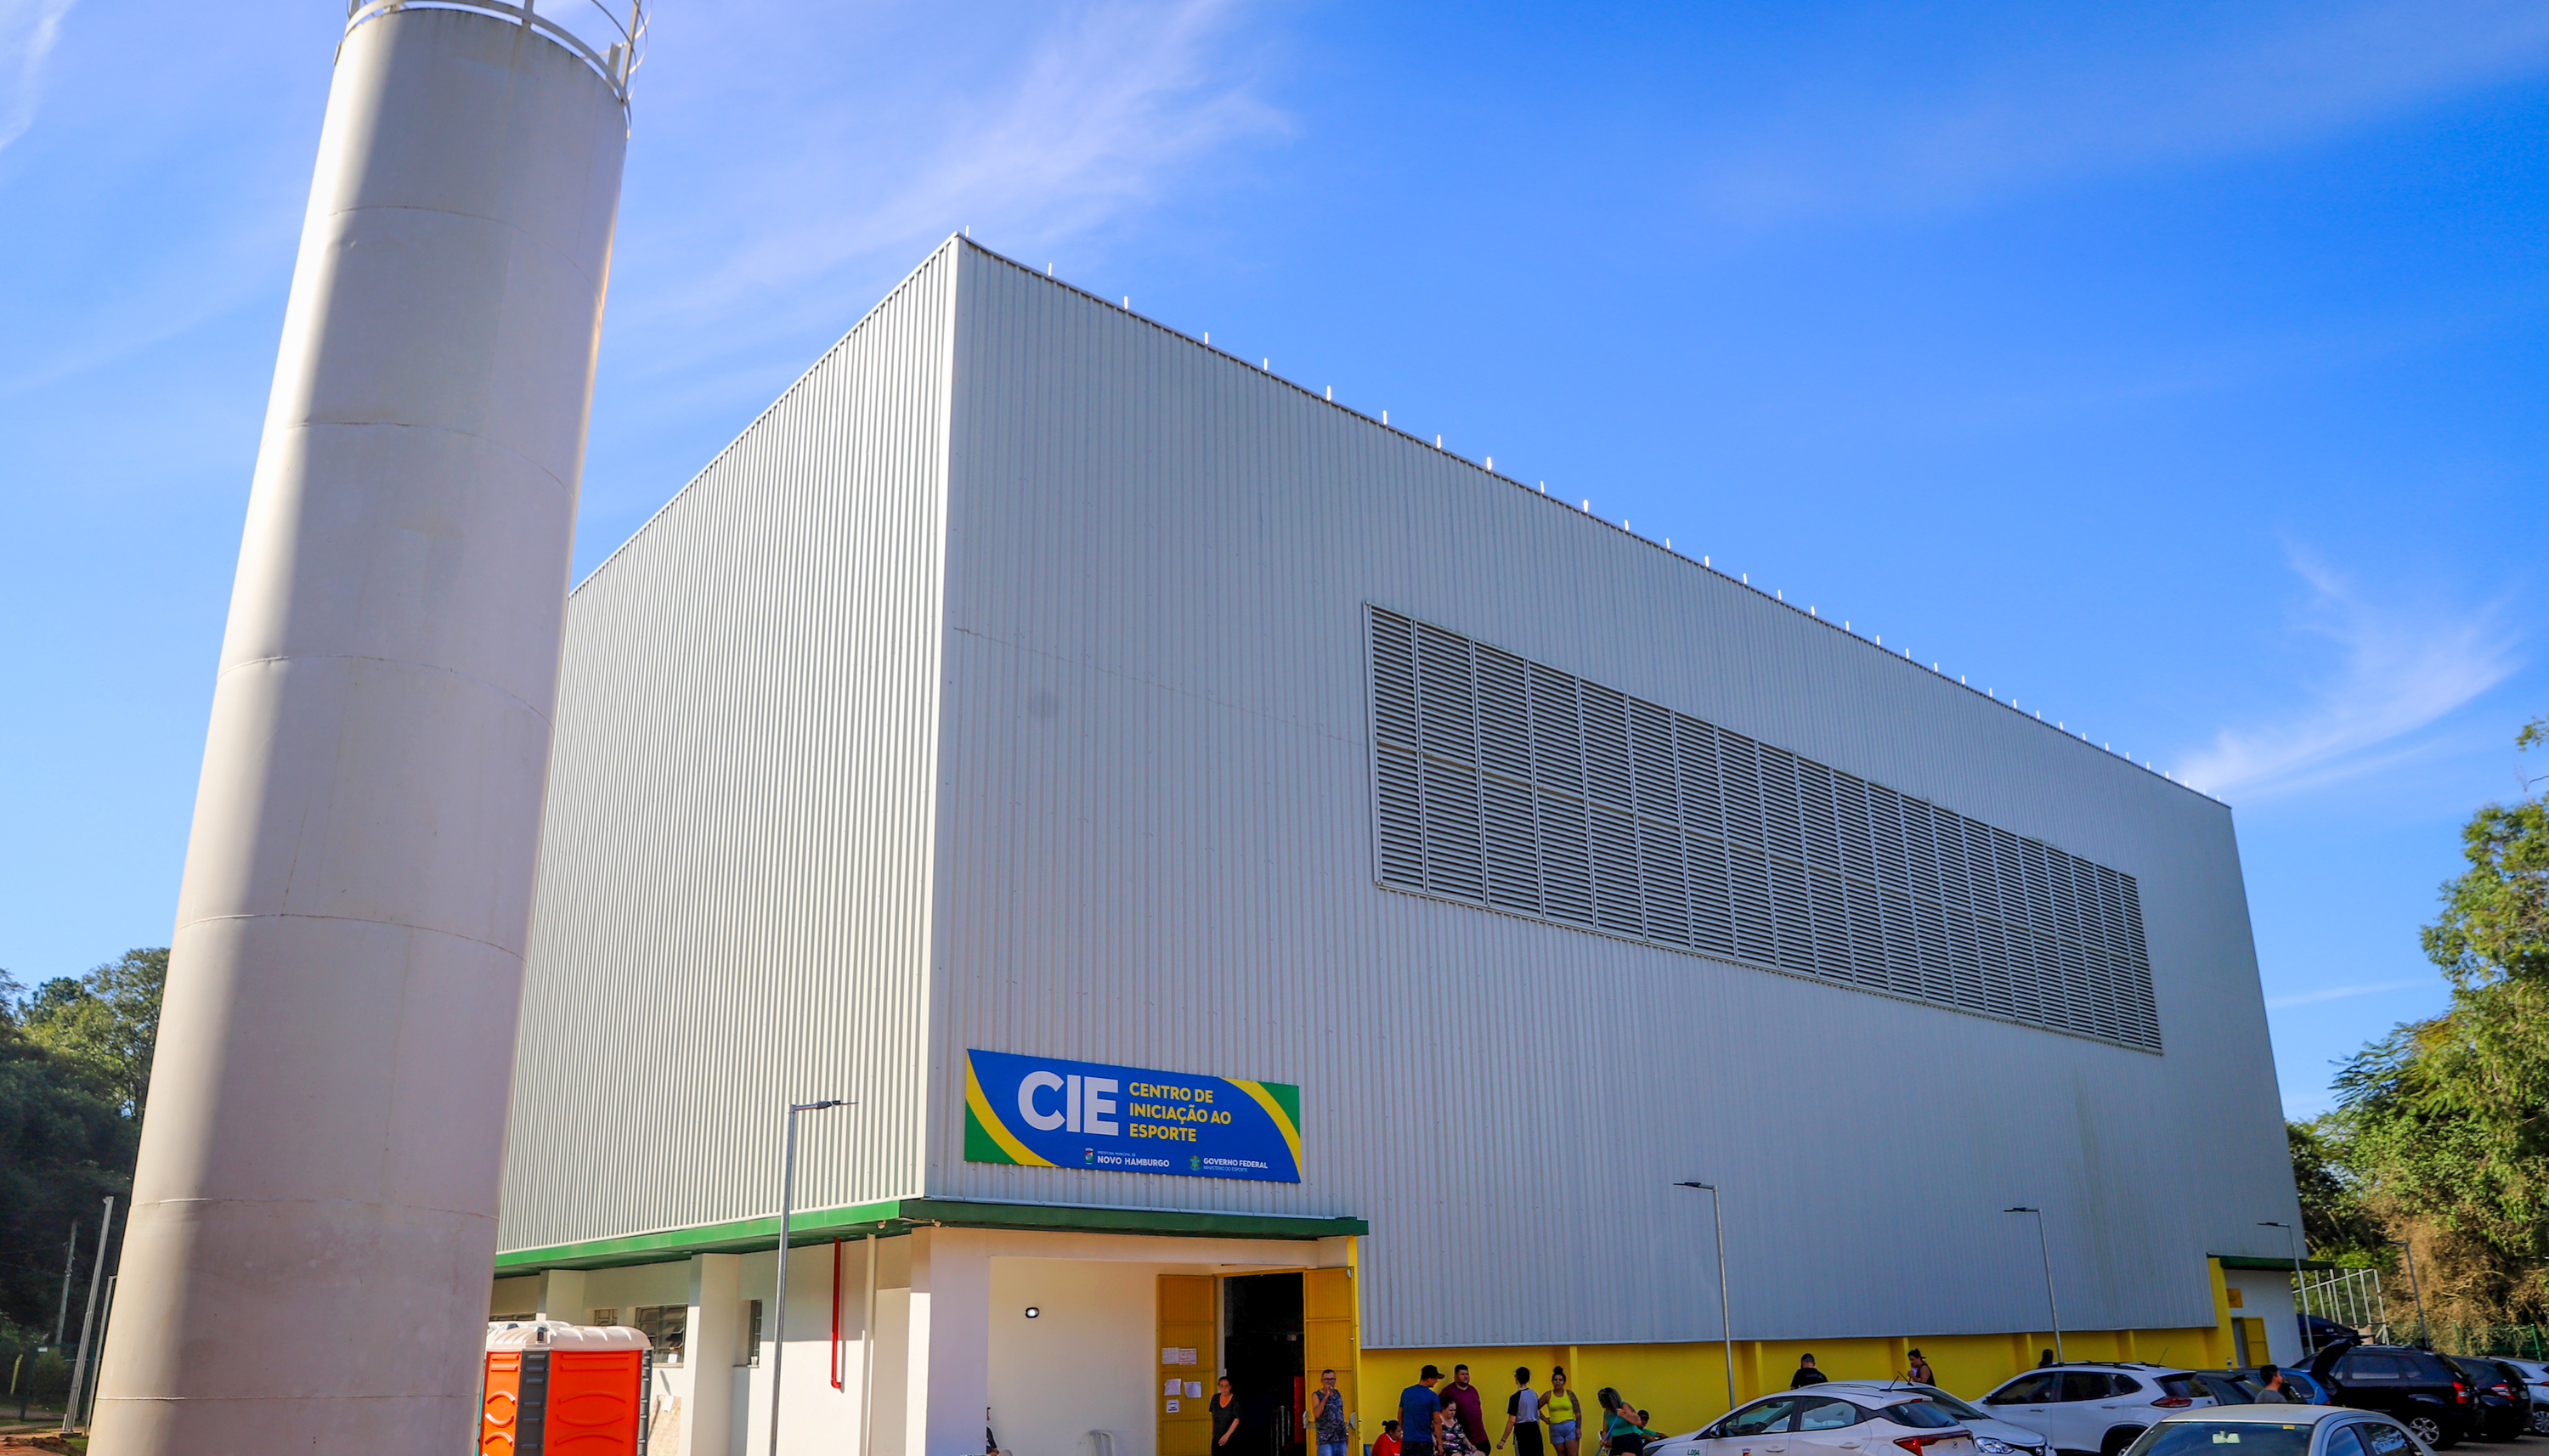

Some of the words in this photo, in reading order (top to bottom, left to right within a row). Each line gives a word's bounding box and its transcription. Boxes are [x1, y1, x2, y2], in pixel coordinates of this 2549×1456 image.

[1129, 1082, 1191, 1101] CENTRO
[1195, 1089, 1213, 1103] DE
[1018, 1070, 1119, 1137] CIE
[1129, 1103, 1208, 1125] INICIAÇÃO
[1210, 1110, 1231, 1125] AO
[1129, 1123, 1196, 1142] ESPORTE
[1097, 1155, 1122, 1165] NOVO
[1124, 1157, 1170, 1167] HAMBURGO
[1203, 1157, 1238, 1166] GOVERNO
[1239, 1160, 1269, 1169] FEDERAL
